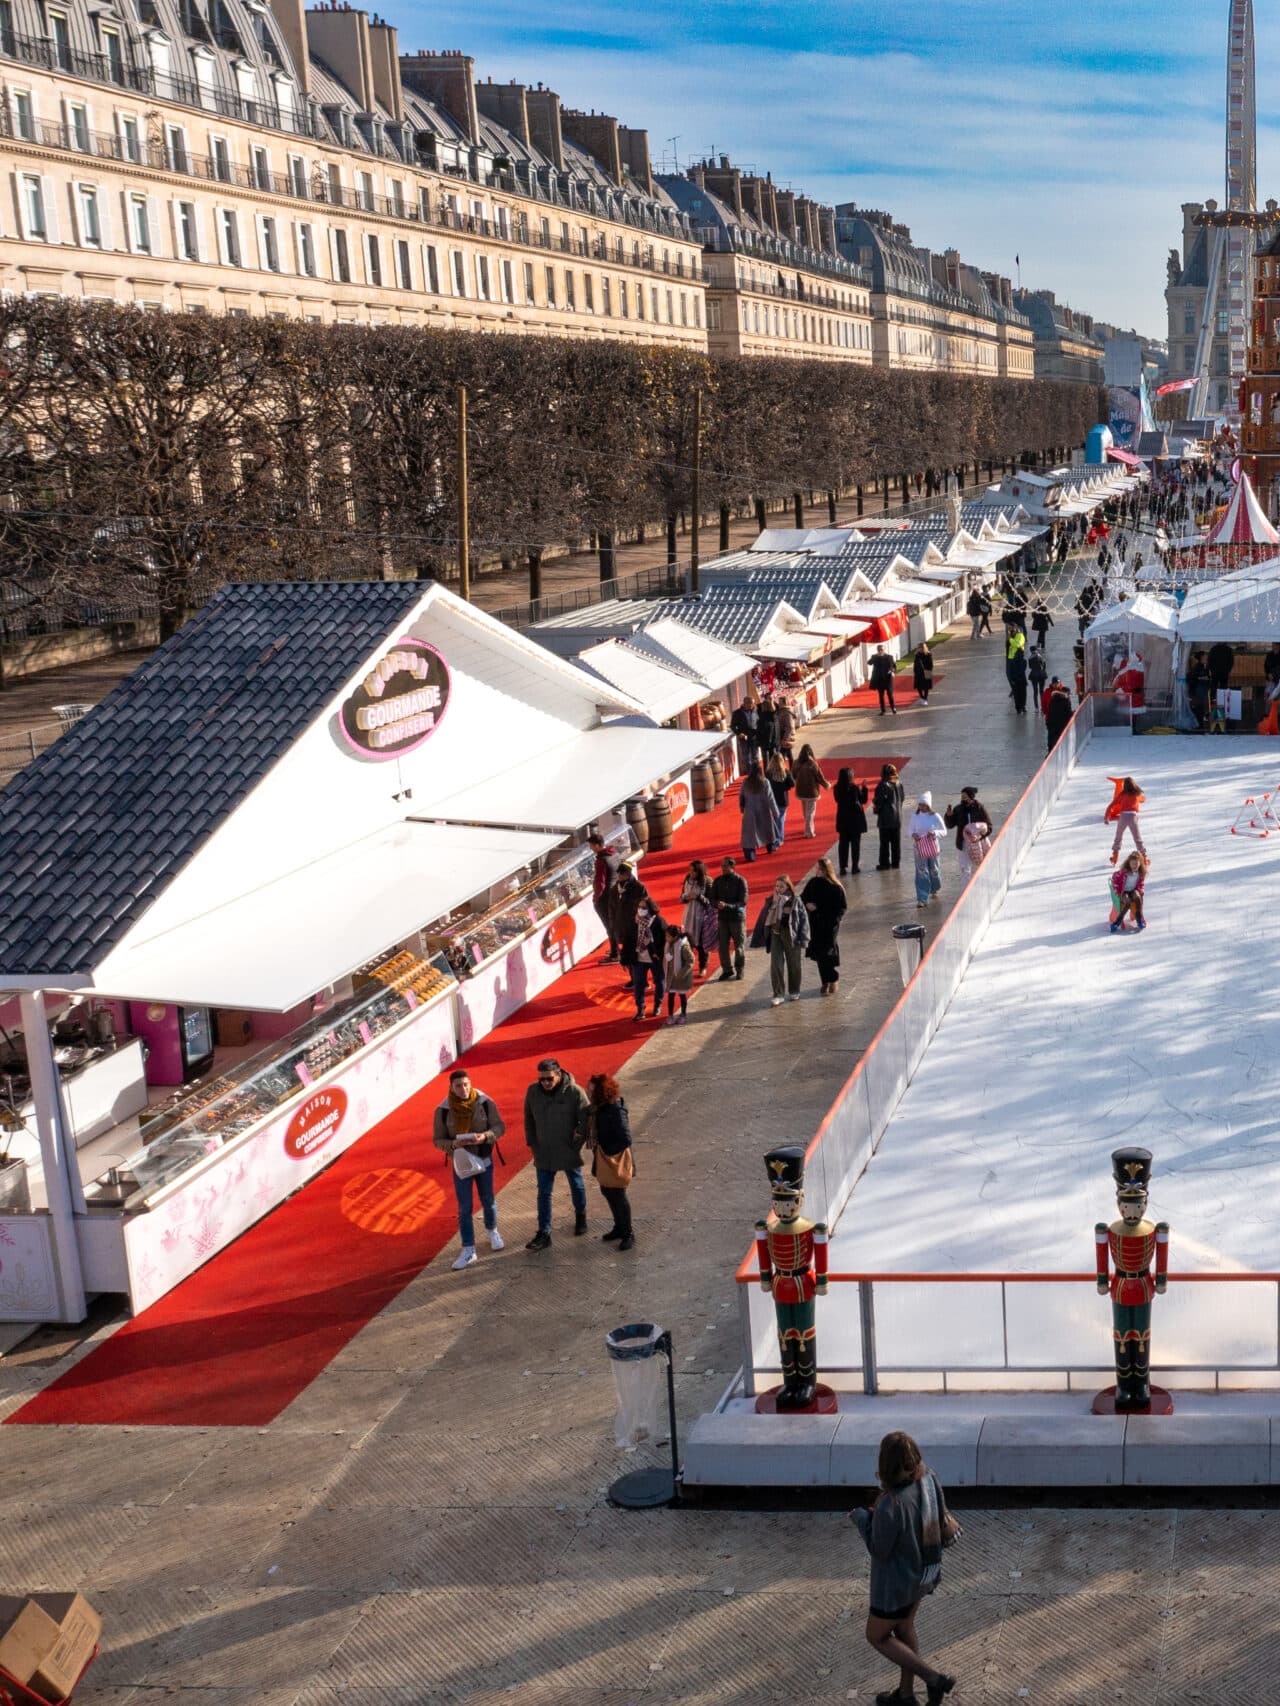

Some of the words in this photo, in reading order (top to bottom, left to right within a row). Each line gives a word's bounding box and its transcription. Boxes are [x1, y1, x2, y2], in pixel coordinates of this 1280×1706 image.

[357, 685, 441, 730] GOURMANDE
[369, 712, 434, 747] CONFISERIE
[295, 1108, 339, 1149] GOURMANDE
[299, 1095, 332, 1127] MAISON
